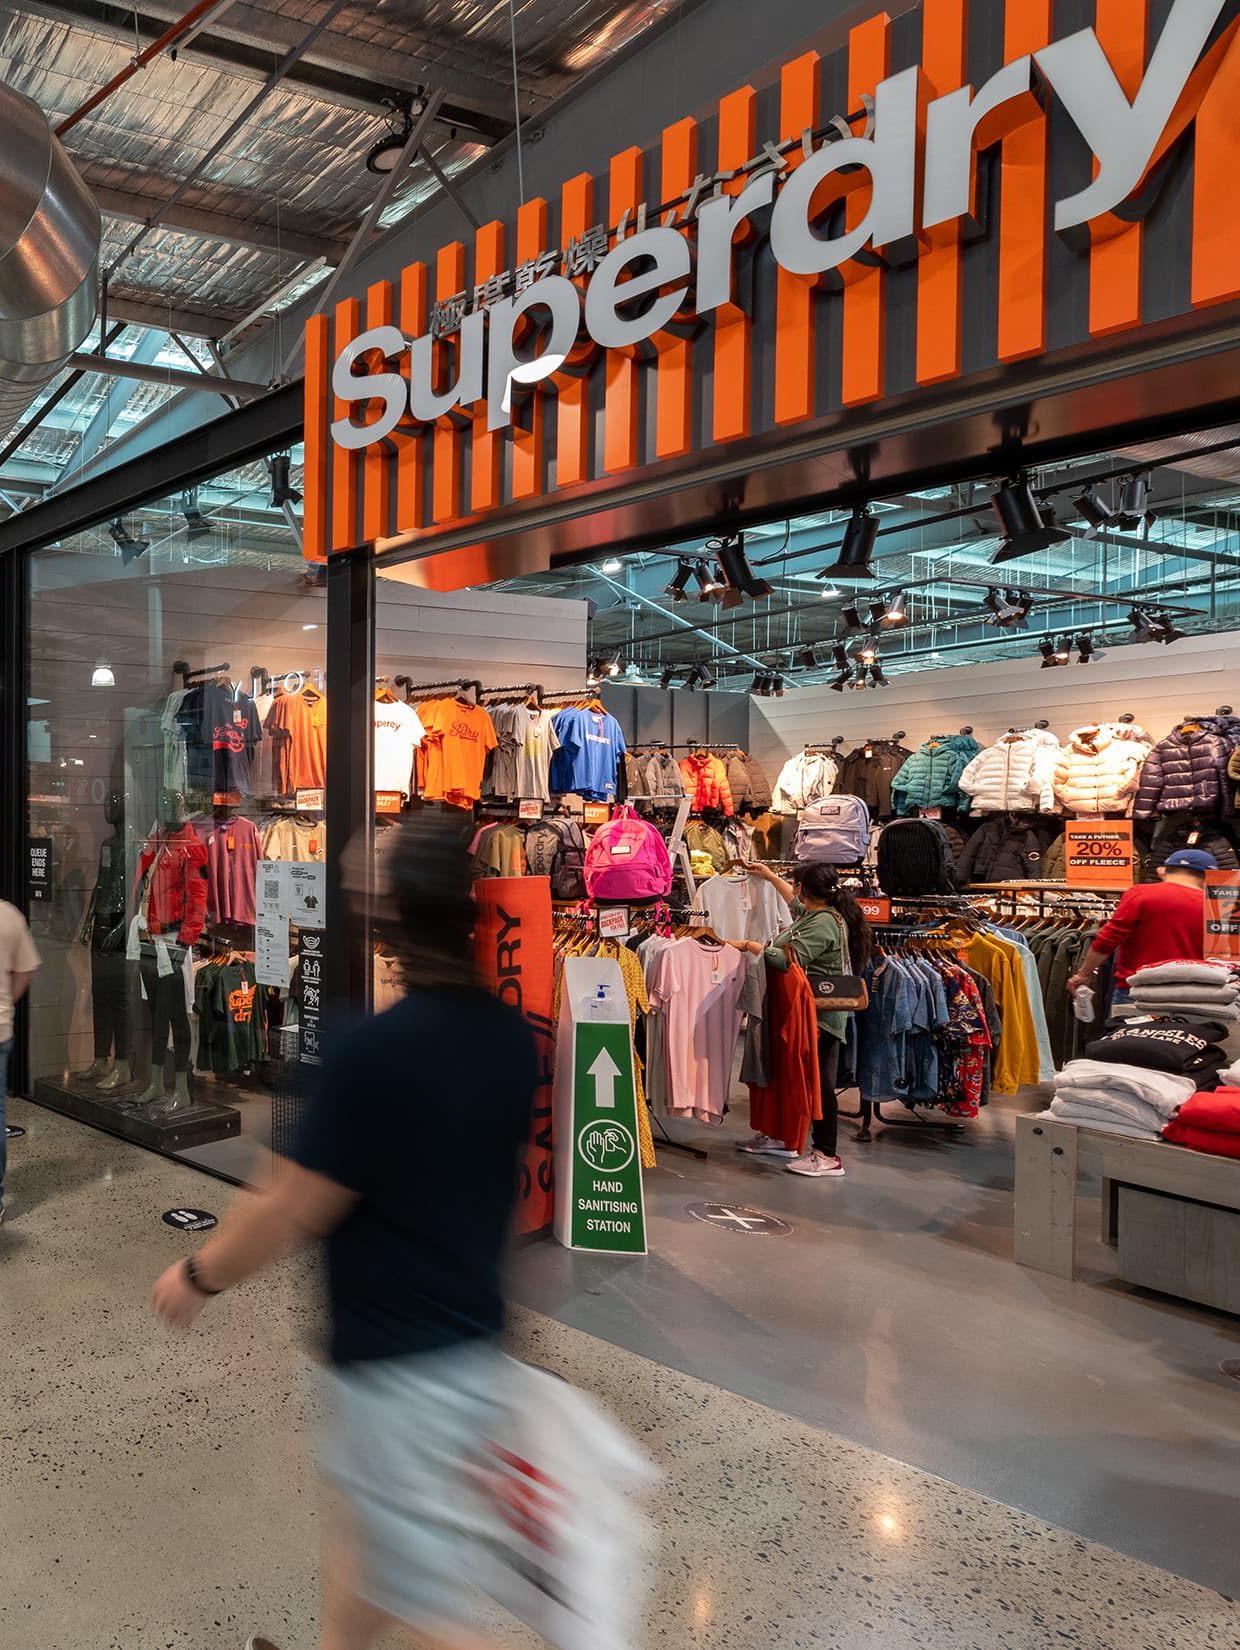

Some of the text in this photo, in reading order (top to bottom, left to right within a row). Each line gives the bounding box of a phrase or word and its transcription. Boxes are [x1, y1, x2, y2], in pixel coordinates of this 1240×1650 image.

[331, 0, 1228, 450] Superdry
[30, 848, 47, 857] QUEUE
[1076, 841, 1122, 856] 20%
[32, 858, 46, 867] ENDS
[31, 867, 46, 877] HERE
[593, 1180, 623, 1193] HAND
[578, 1198, 638, 1214] SANITISING
[586, 1219, 631, 1233] STATION
